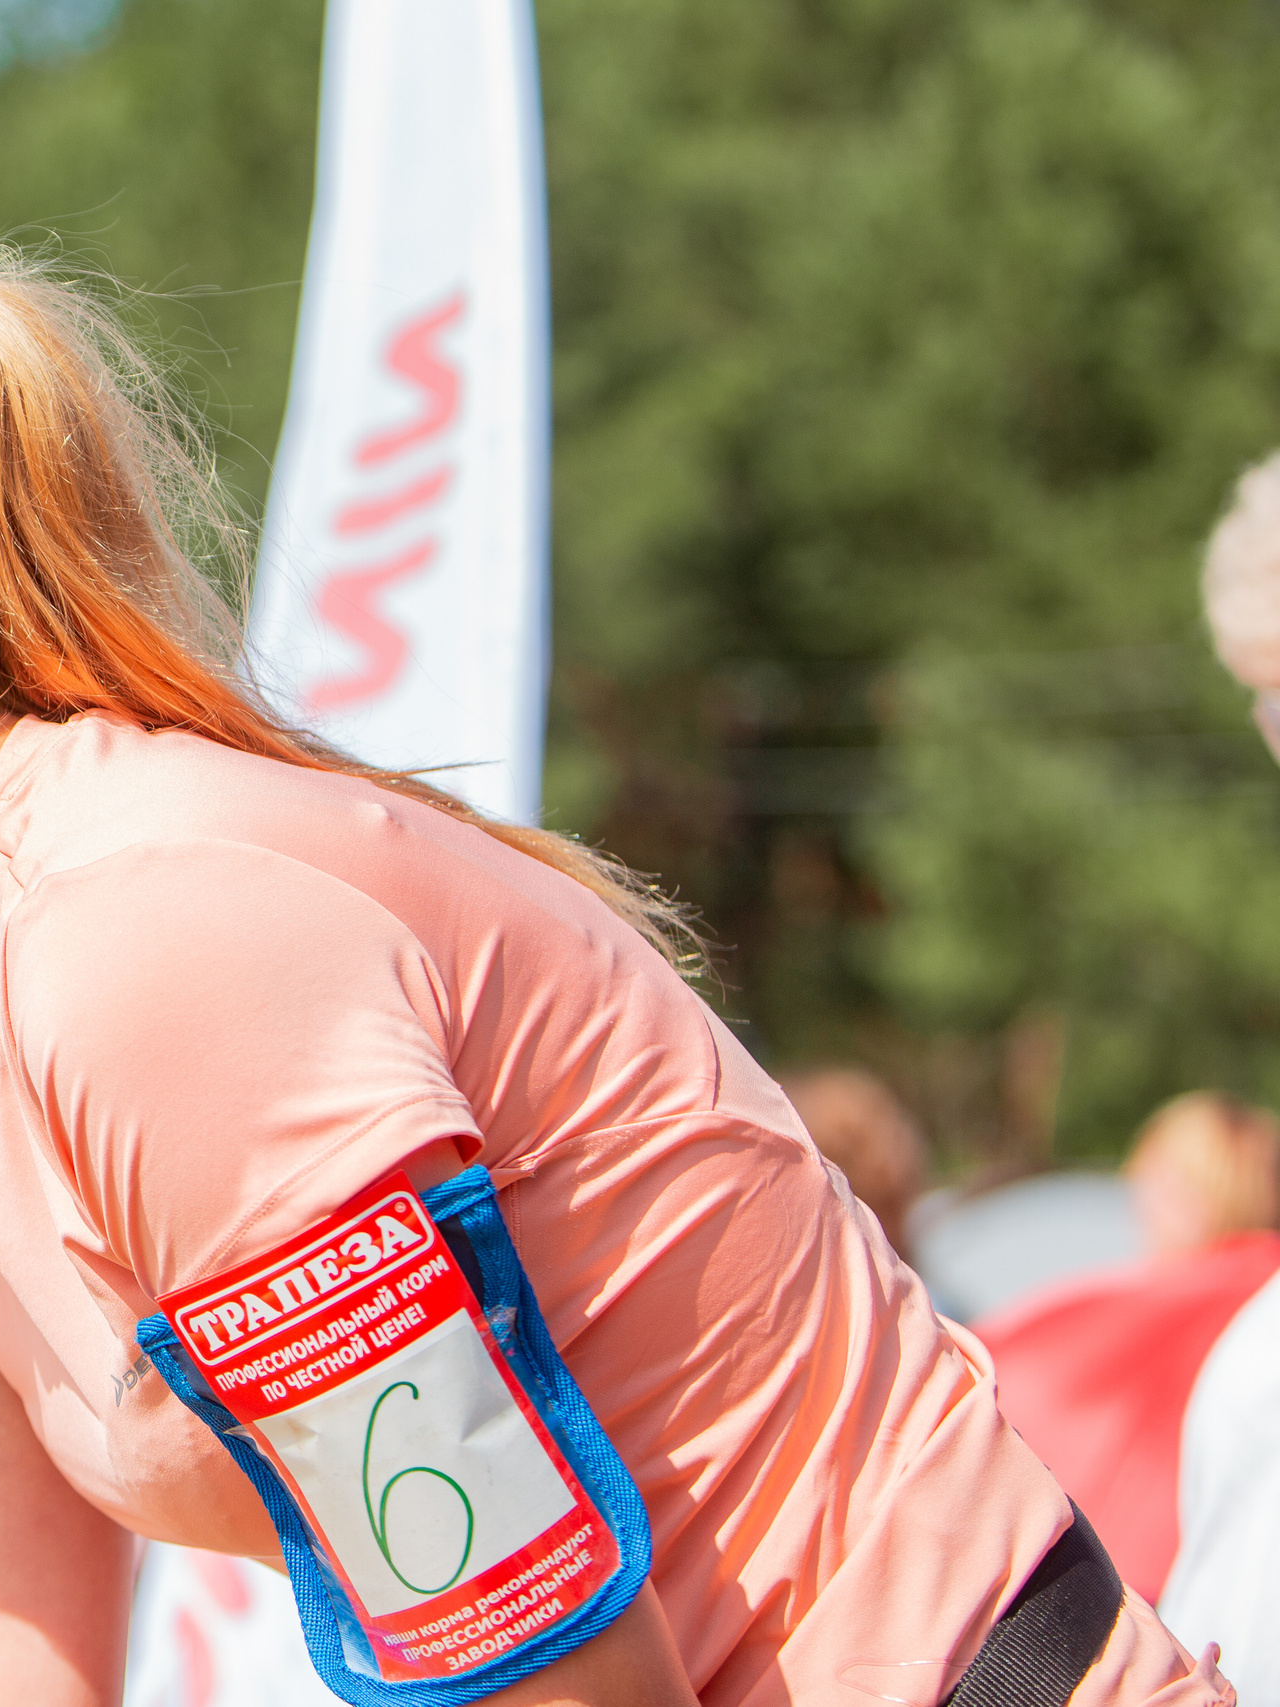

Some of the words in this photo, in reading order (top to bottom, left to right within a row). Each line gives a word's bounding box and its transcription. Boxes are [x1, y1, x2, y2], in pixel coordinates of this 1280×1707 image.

[122, 1354, 153, 1391] DE
[215, 1286, 399, 1391] ПРОФЕССИОНАЛЬНЫЙ
[397, 1254, 450, 1300] КОРМ
[261, 1380, 287, 1402] ПО
[285, 1334, 370, 1391] ЧЕСТНОЙ
[367, 1302, 427, 1349] ЦЕНЕ!
[363, 1380, 474, 1594] 6
[382, 1629, 420, 1647] наши
[421, 1604, 476, 1638] корма
[474, 1522, 593, 1614] рекомендуют
[401, 1548, 594, 1662] ПРОФЕССИОНАЛЬНЫЕ
[445, 1597, 564, 1671] ЗАВОДЧИКИ
